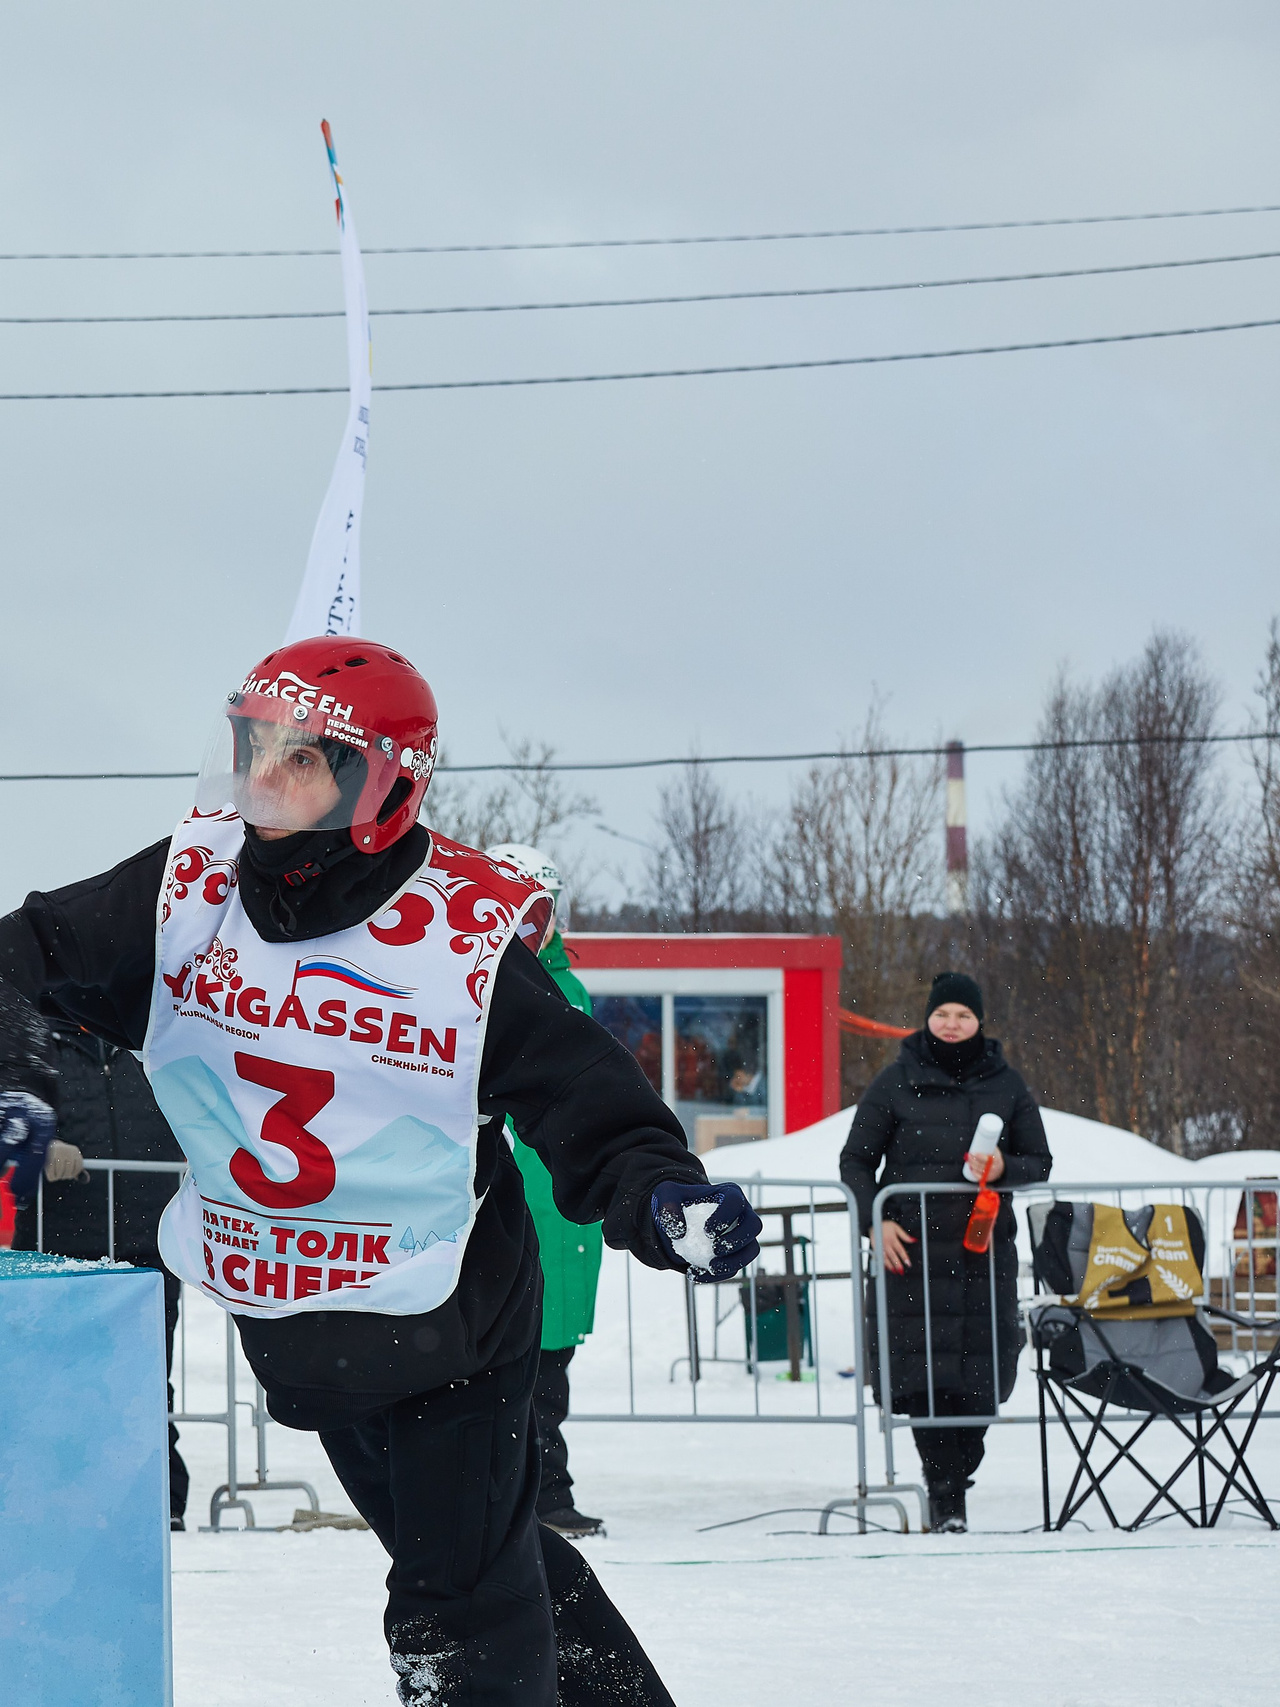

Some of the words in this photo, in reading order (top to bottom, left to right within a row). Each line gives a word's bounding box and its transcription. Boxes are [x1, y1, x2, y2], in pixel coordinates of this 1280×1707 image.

[327, 718, 365, 736] ПЕРВЫЕ
[324, 728, 332, 736] В
[332, 732, 369, 748] РОССИИ
[225, 1025, 260, 1041] REGION
[371, 1055, 429, 1073] СНЕЖНЫЙ
[432, 1066, 454, 1078] БОЙ
[229, 1051, 336, 1209] 3
[203, 1208, 218, 1225] ЛЯ
[220, 1217, 259, 1237] ТЕХ,
[214, 1232, 259, 1251] ЗНАЕТ
[270, 1226, 391, 1264] ТОЛК
